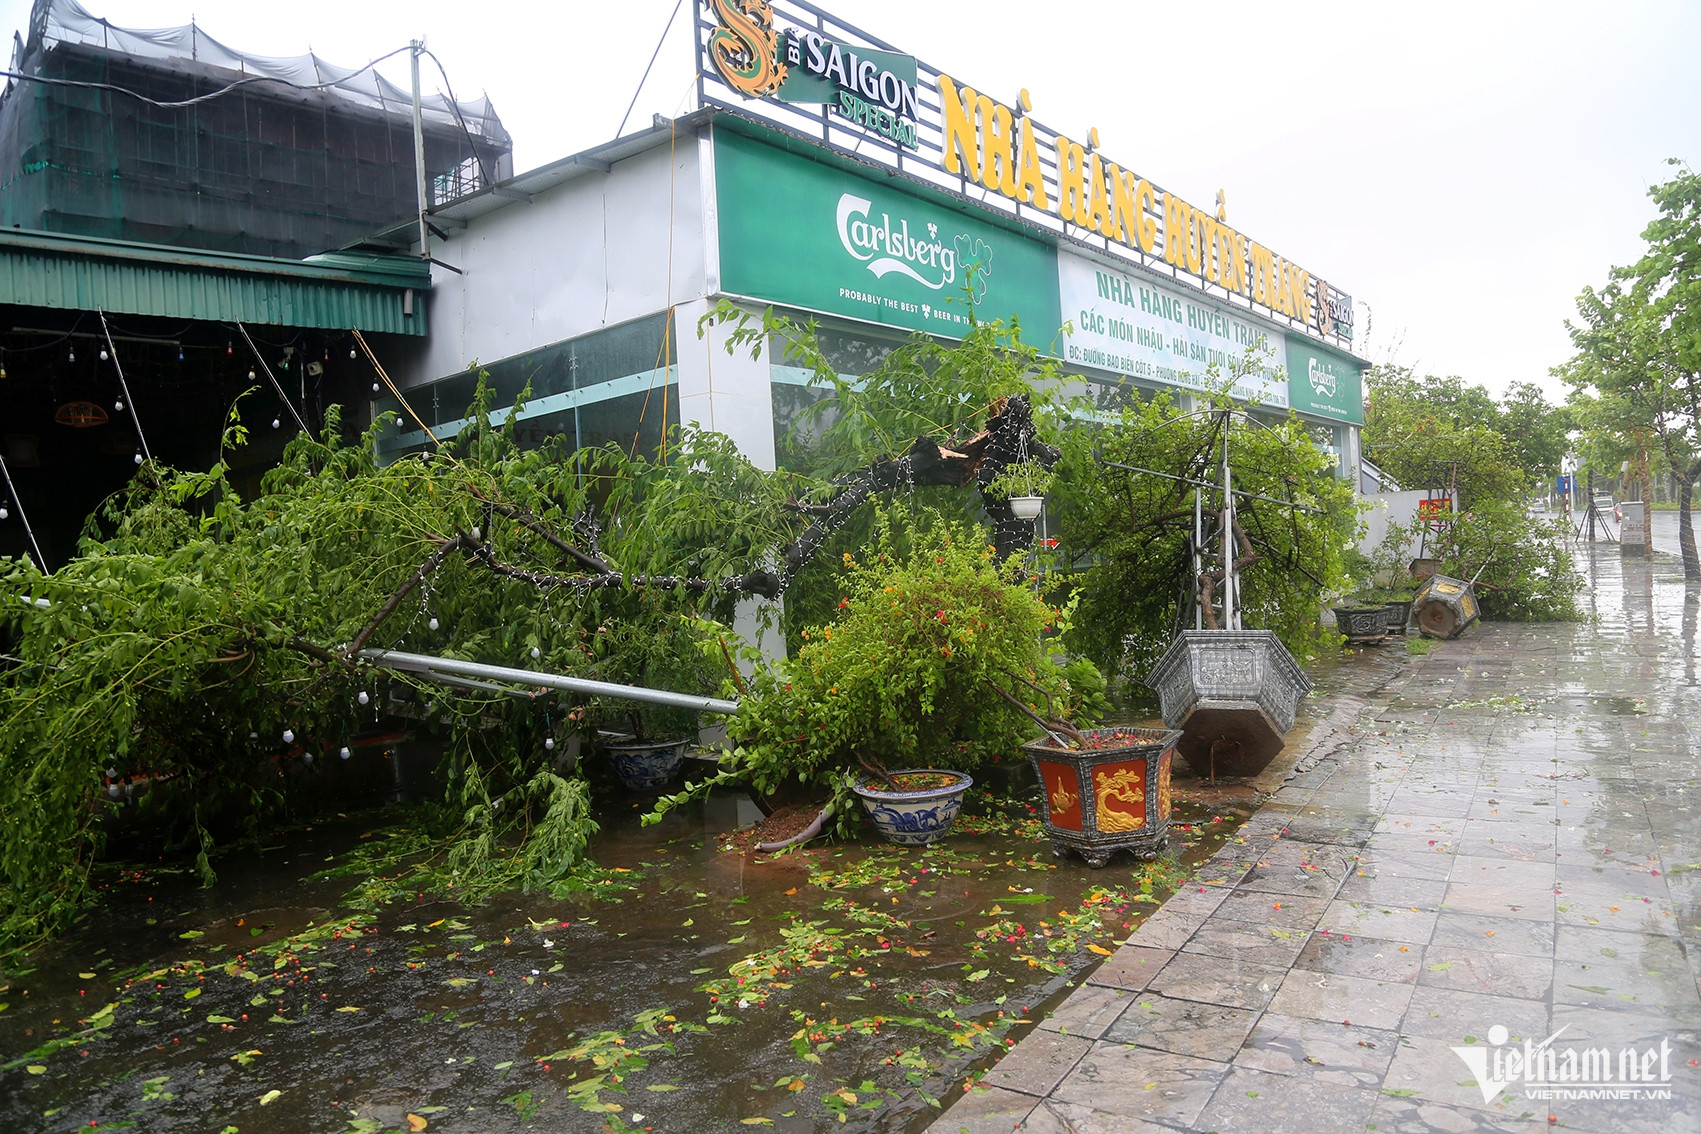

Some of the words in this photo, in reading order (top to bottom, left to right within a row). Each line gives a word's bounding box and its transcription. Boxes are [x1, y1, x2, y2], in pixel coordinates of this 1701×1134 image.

[784, 27, 800, 65] BIA
[806, 32, 919, 121] SAIGON
[838, 90, 919, 150] SPECIAL
[935, 74, 1048, 210] NHÀ
[1053, 127, 1156, 254] HÀNG
[1248, 240, 1311, 324] TRANG
[836, 193, 957, 289] Carlsberg
[839, 288, 881, 305] PROBABLY
[884, 298, 898, 309] THE
[901, 302, 918, 313] BEST
[934, 309, 951, 321] BEER
[953, 314, 961, 323] IN
[1080, 308, 1105, 335] CÁC
[1108, 317, 1134, 343] MÓN
[1136, 326, 1163, 353] NHẬU
[1173, 335, 1188, 358] HẢI
[1190, 340, 1207, 362] SẢN
[1096, 271, 1135, 308] NHÀ
[1139, 286, 1183, 324] HÀNG
[1233, 321, 1269, 353] TRANG
[1069, 345, 1082, 360] ĐC:
